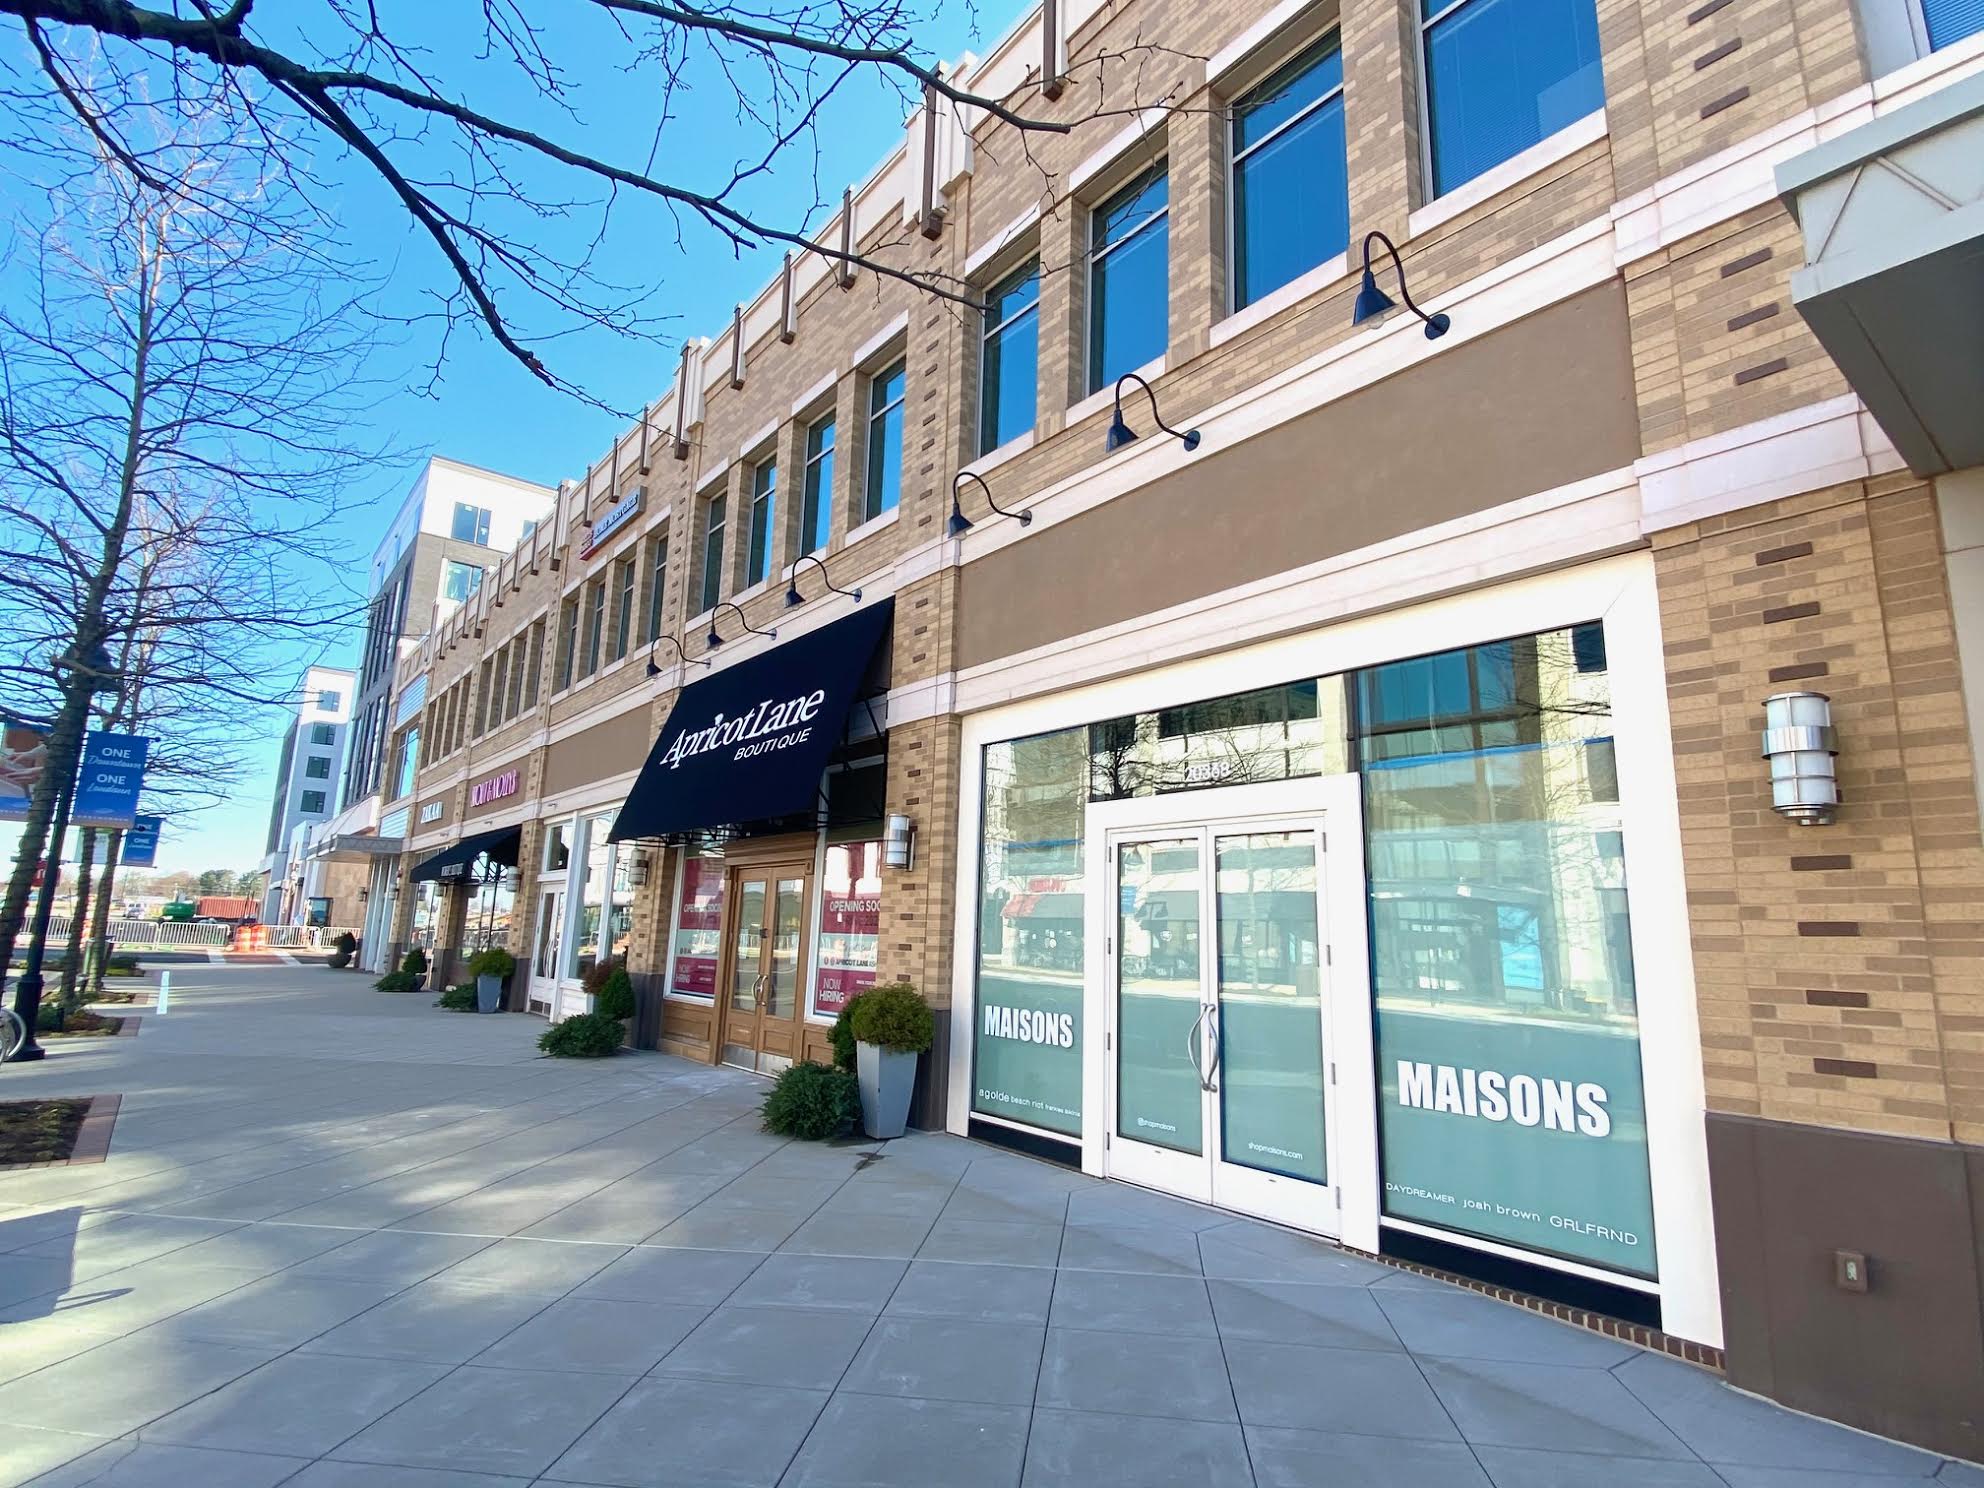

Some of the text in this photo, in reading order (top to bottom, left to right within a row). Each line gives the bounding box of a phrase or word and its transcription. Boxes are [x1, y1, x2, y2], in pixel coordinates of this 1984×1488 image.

[659, 689, 825, 770] Apricot Lane
[101, 747, 131, 759] ONE
[733, 727, 813, 761] BOUTIQUE
[96, 774, 126, 785] ONE
[829, 900, 865, 912] OPENING
[823, 977, 842, 991] NOW
[819, 990, 845, 1003] HIRING
[984, 1004, 1074, 1049] MAISONS
[1397, 1060, 1611, 1137] MAISONS
[1247, 1141, 1304, 1160] shopmaisons.com
[1385, 1182, 1456, 1204] DAYDREAMER
[1496, 1203, 1541, 1222] brown
[1549, 1215, 1639, 1246] GRLFRND
